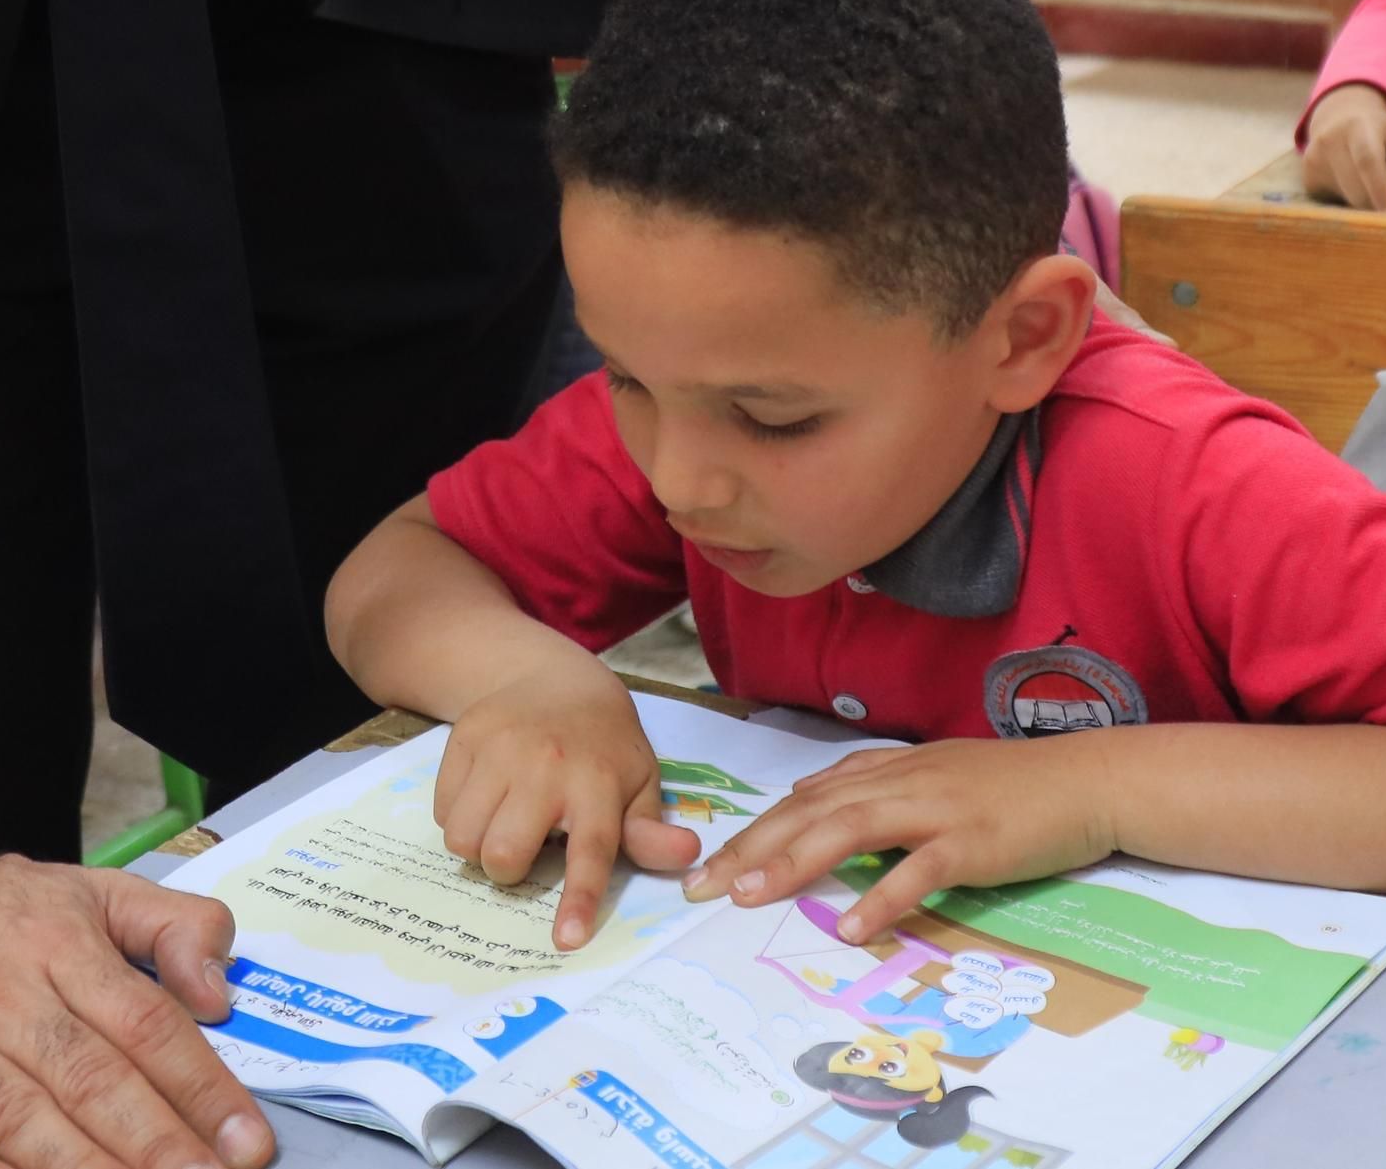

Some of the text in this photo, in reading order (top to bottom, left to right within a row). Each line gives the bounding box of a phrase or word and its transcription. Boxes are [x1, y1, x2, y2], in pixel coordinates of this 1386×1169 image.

[405, 913, 421, 924] ما
[1003, 992, 1042, 1006] الصدق
[597, 1082, 655, 1134] الجنة
